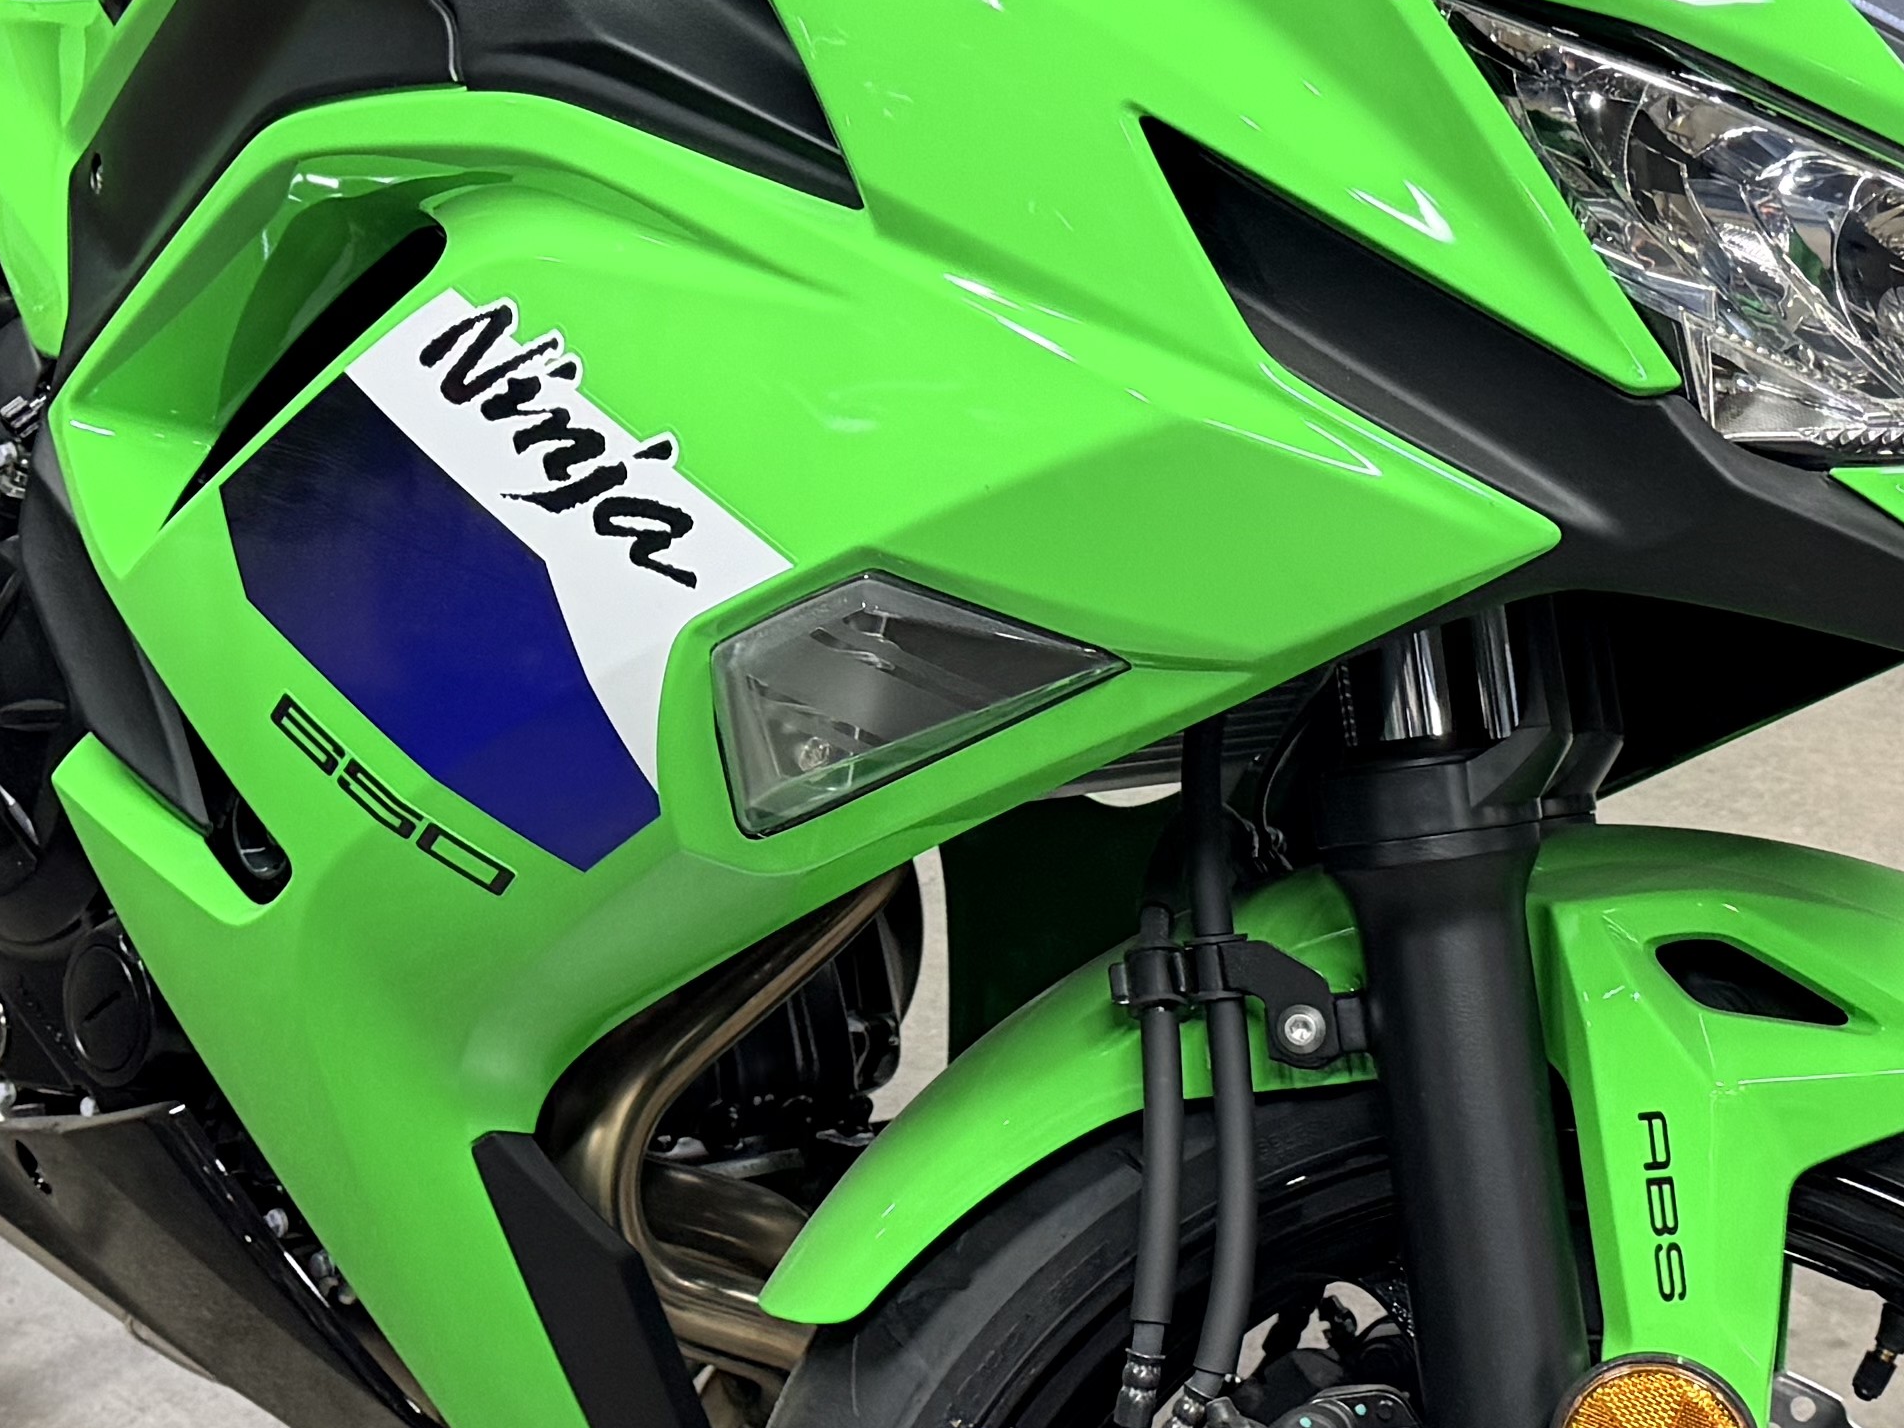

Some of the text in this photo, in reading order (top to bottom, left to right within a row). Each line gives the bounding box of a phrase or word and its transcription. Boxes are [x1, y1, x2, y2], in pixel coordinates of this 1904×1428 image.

[419, 305, 697, 589] Ninja
[271, 692, 516, 896] 650
[1637, 1110, 1688, 1303] ABS
